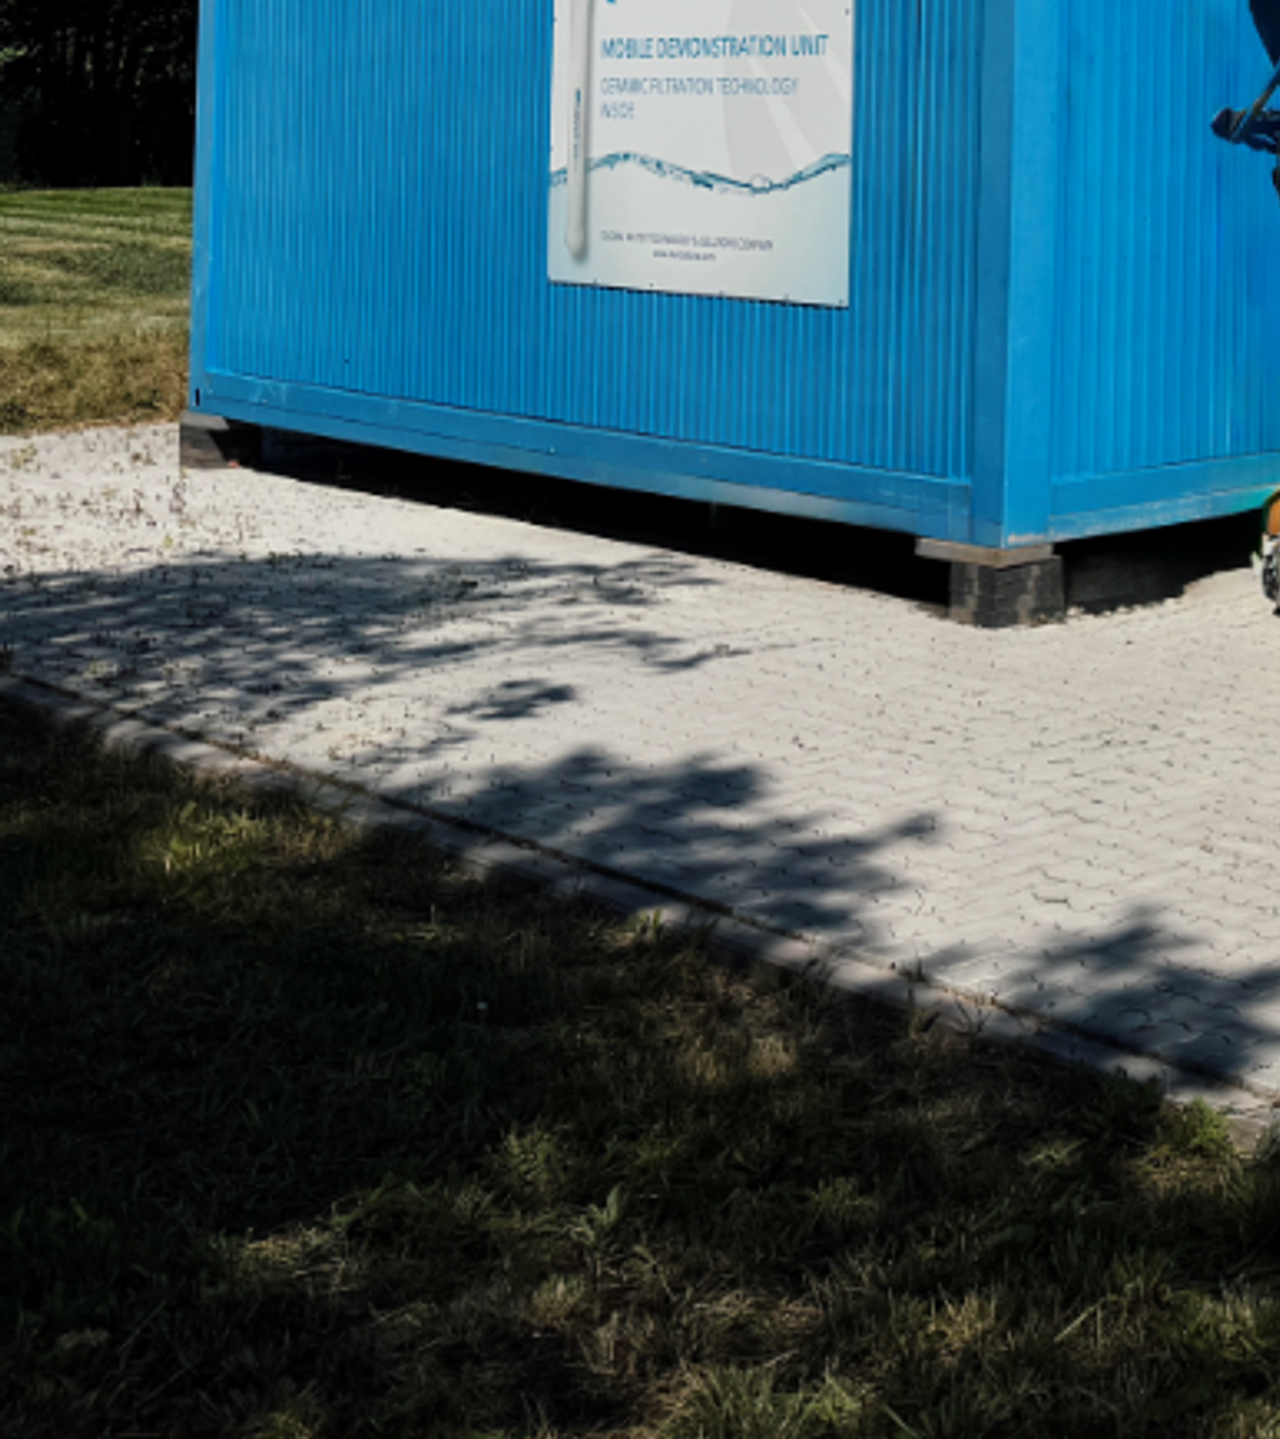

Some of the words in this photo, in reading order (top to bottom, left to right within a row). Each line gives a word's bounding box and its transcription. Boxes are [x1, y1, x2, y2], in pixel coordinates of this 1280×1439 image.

[601, 37, 654, 59] MOBILE
[656, 34, 787, 59] DEMONSTRATION
[792, 33, 829, 57] UNIT
[716, 76, 799, 96] TECHNOLOGY
